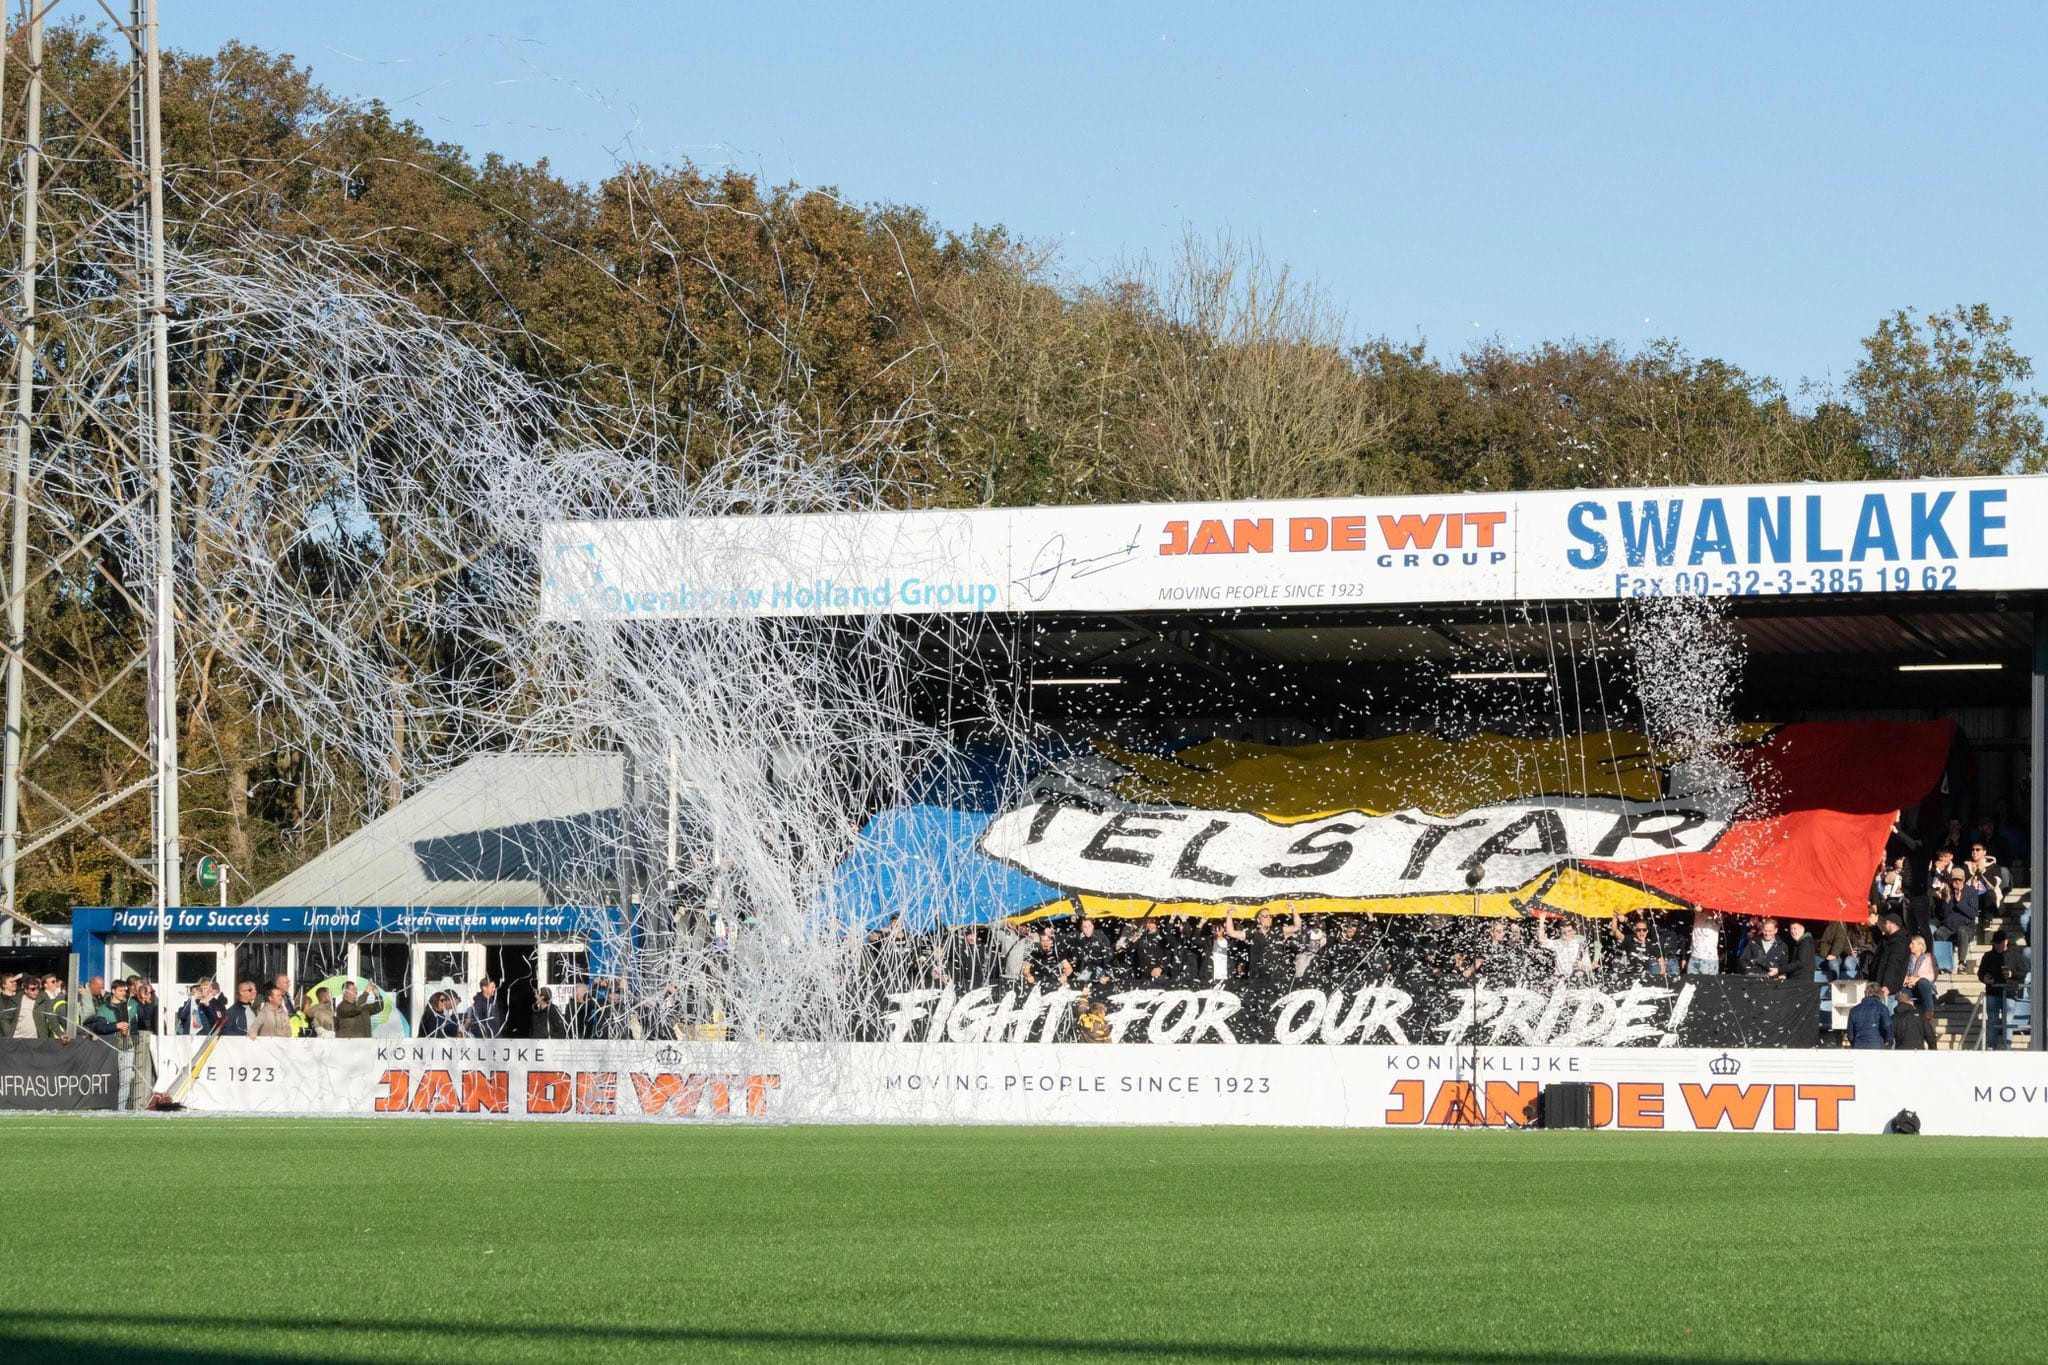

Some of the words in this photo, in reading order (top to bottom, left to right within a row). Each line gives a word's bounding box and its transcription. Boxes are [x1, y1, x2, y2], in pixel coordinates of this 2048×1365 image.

[1159, 518, 1274, 556] JAN
[1289, 515, 1367, 552] DE
[1376, 511, 1507, 550] WIT
[1566, 489, 2009, 570] SWANLAKE
[1377, 551, 1507, 568] GROUP
[772, 577, 891, 609] Holland
[900, 577, 998, 612] Group
[1158, 586, 1221, 600] MOVING
[1226, 585, 1280, 599] PEOPLE
[1284, 584, 1326, 598] SINCE
[1331, 583, 1365, 597] 1923
[1614, 573, 1664, 598] Fax
[1675, 567, 1864, 596] 00-32-3-385
[1877, 566, 1911, 593] 19
[1922, 565, 1958, 592] 62
[1024, 788, 1708, 888] TELSTAR
[112, 911, 173, 930] Playing
[178, 911, 203, 927] for
[207, 911, 270, 926] Success
[397, 914, 431, 926] Leren
[436, 914, 460, 926] met
[464, 915, 487, 926] een
[491, 913, 565, 926] wow-factor
[879, 985, 1086, 1043] FIGHT
[1104, 985, 1242, 1044] FOR
[1270, 982, 1413, 1045] OUR
[1431, 980, 1697, 1048] PRIDE!
[228, 1066, 275, 1082] 1923
[1387, 1055, 1580, 1072] KONINKLIJKE
[374, 1069, 509, 1114] JAN
[526, 1071, 617, 1115] DE
[629, 1072, 781, 1116] WIT
[886, 1075, 988, 1091] MOVING
[1005, 1075, 1107, 1092] PEOPLE
[1120, 1076, 1199, 1092] SINCE
[1214, 1076, 1271, 1094] 1923
[1974, 1086, 2048, 1103] MOVI
[1385, 1080, 1539, 1125] JAN
[1679, 1083, 1856, 1132] WIT
